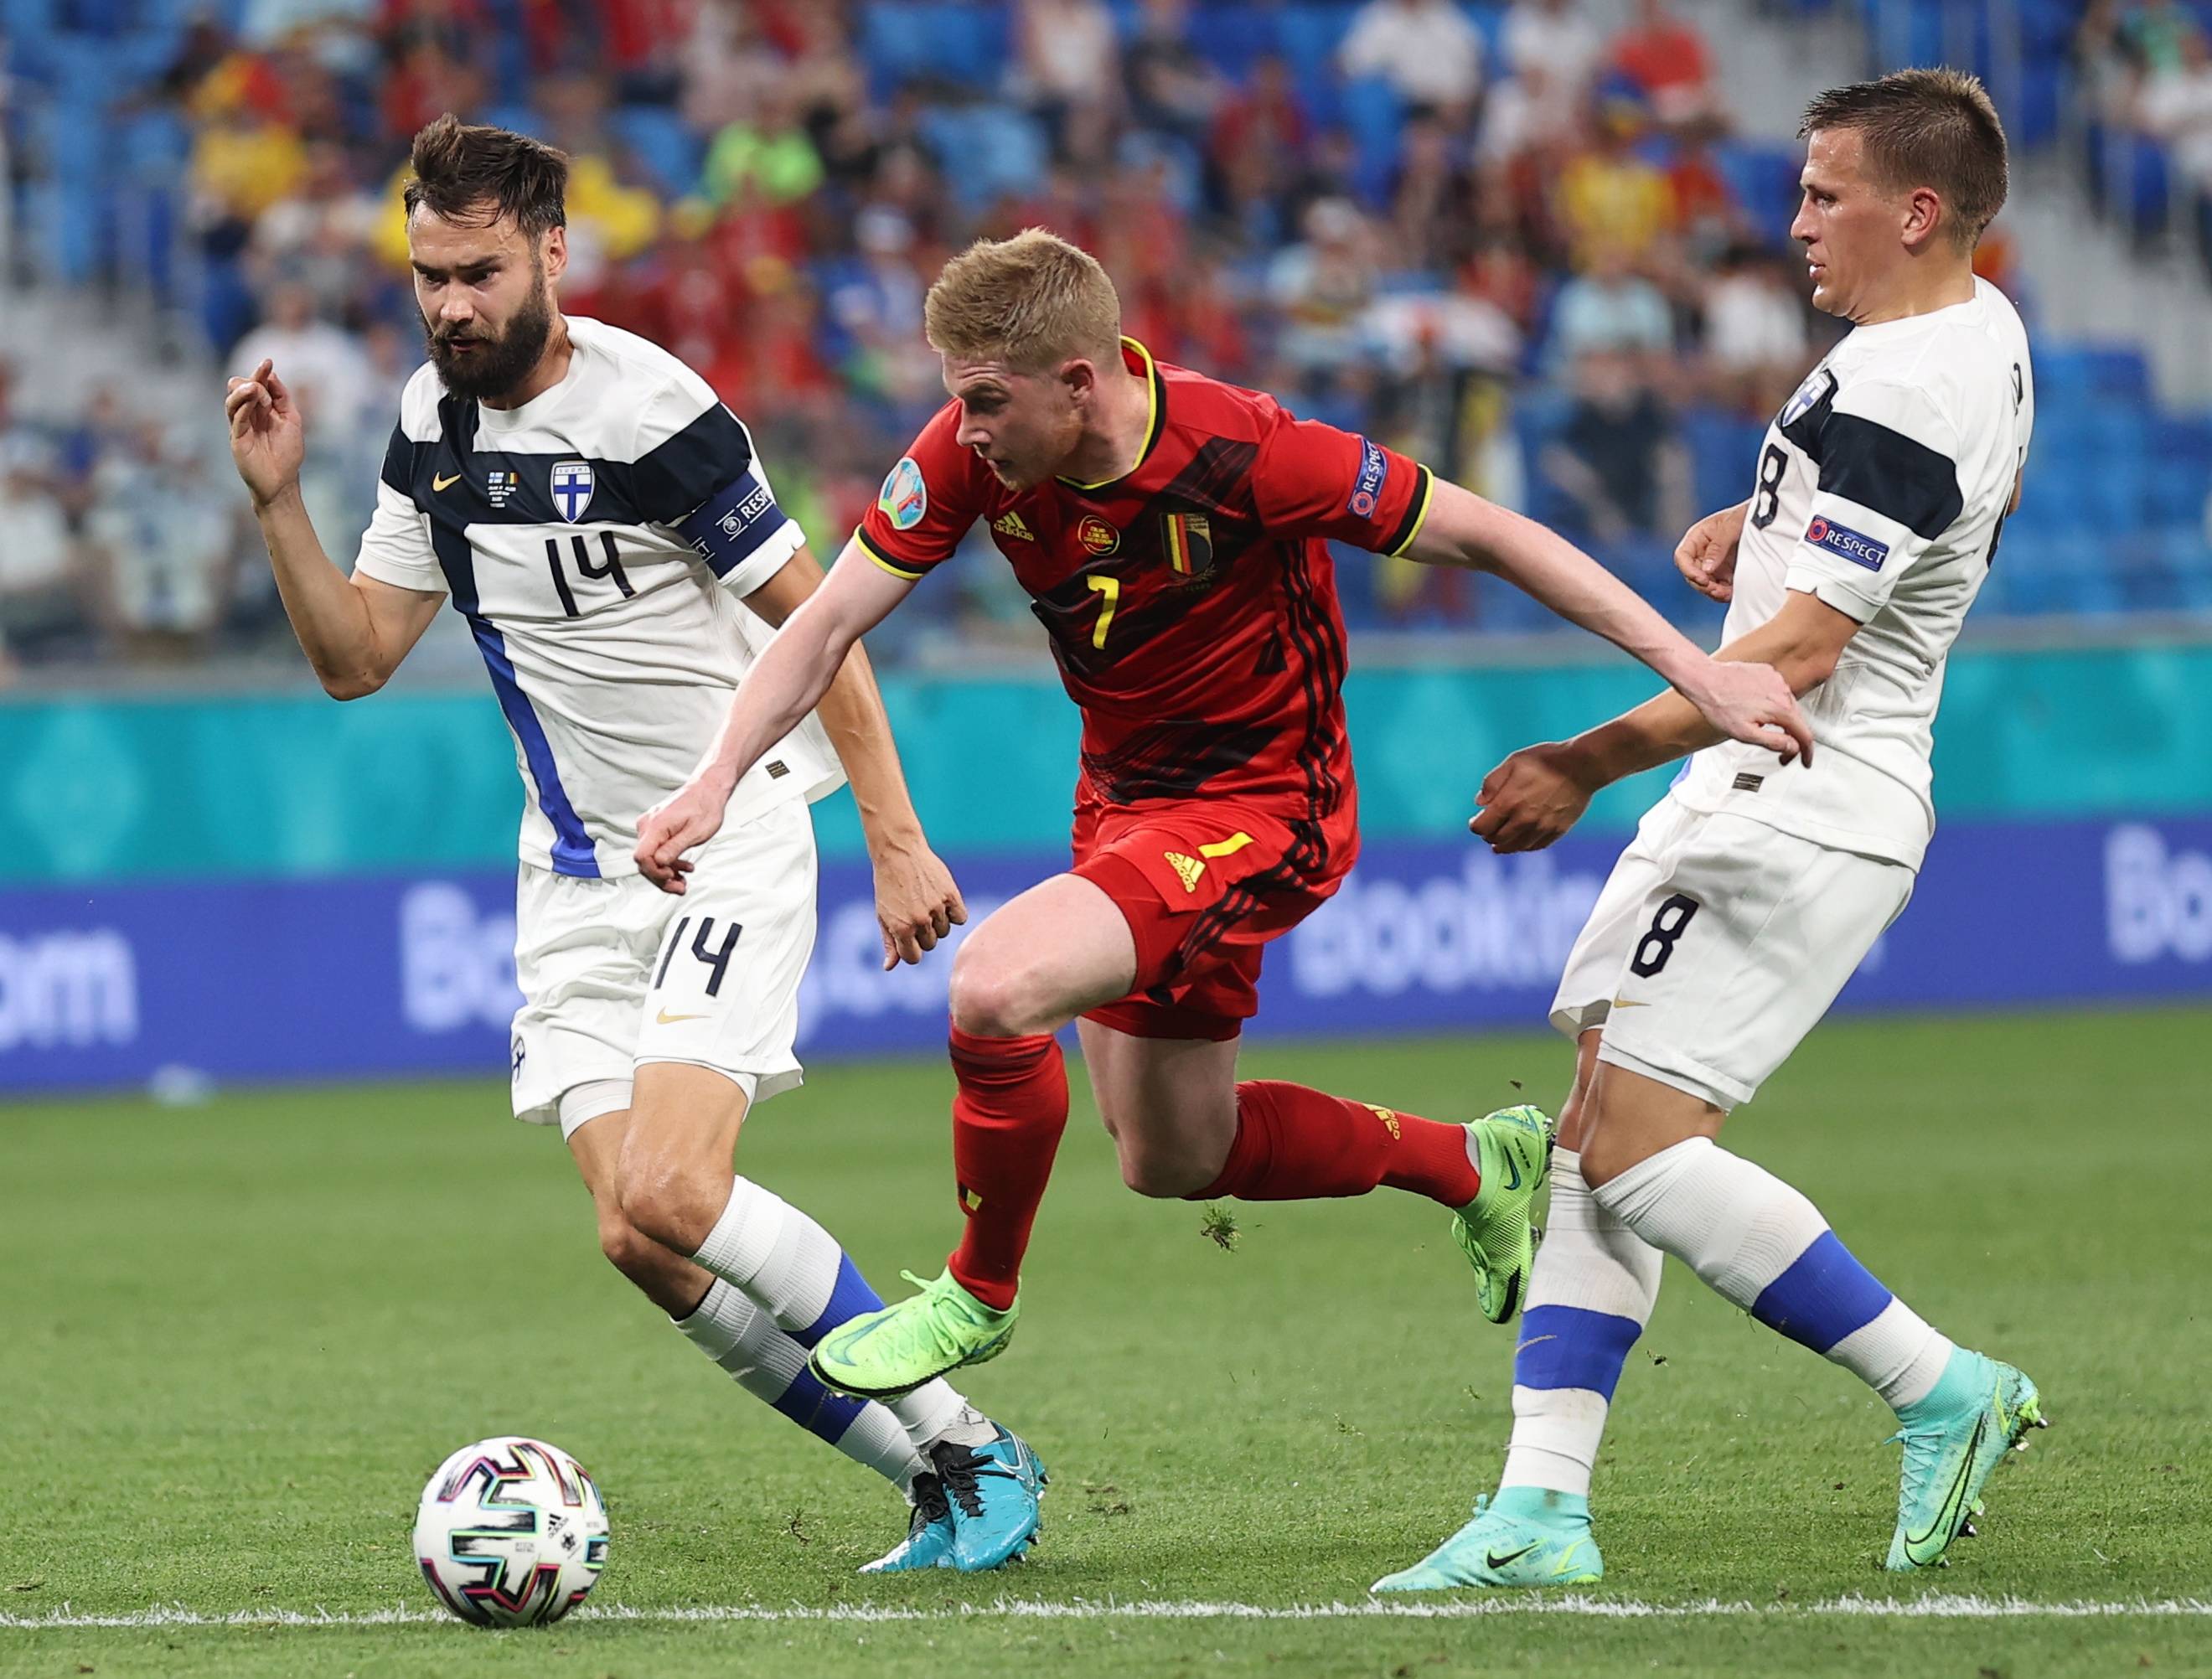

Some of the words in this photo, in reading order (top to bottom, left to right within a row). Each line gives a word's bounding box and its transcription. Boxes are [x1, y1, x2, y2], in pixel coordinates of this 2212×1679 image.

[1751, 442, 1789, 531] 8
[994, 522, 1036, 542] adidas
[1826, 530, 1885, 564] RESPECT
[545, 530, 637, 617] 14
[1087, 574, 1119, 650] 7
[1163, 851, 1196, 893] adidas
[654, 917, 743, 998] 14
[1630, 893, 1699, 979] 8
